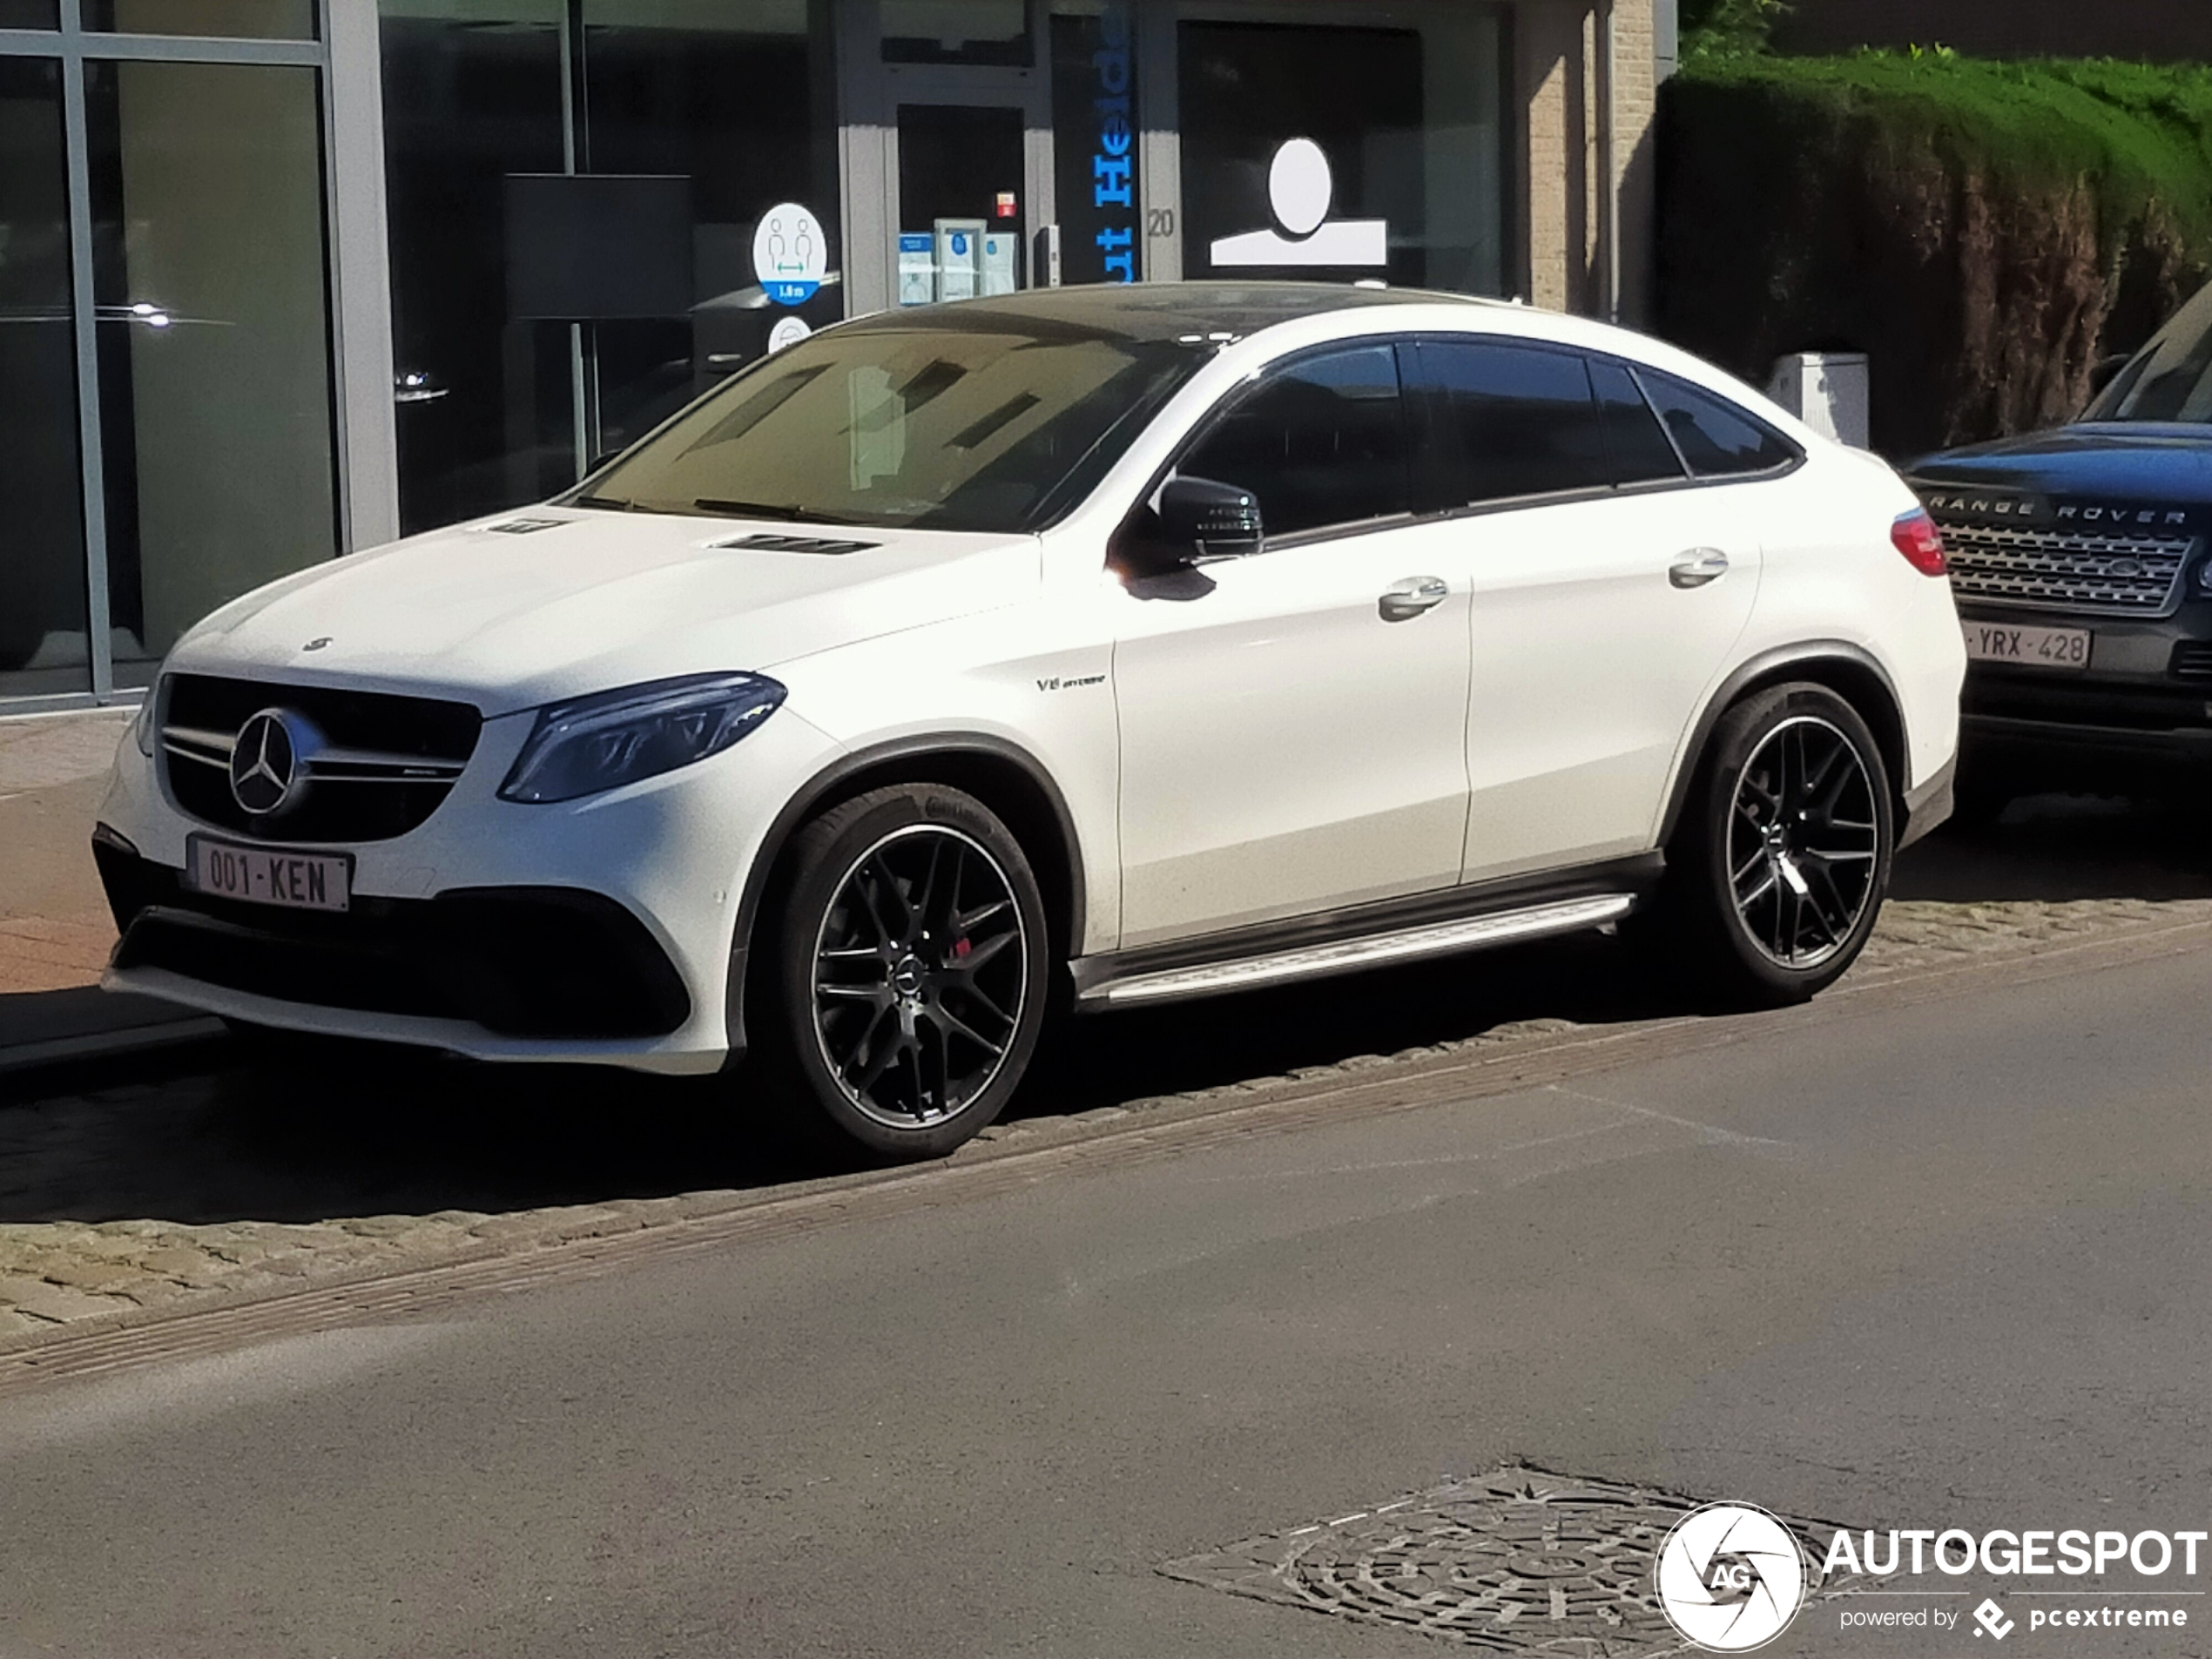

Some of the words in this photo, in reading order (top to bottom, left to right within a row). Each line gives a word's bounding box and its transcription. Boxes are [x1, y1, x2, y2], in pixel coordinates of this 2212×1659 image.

[1148, 209, 1174, 237] 20
[1929, 496, 2036, 516] RANGE
[2056, 505, 2187, 524] ROVER
[210, 849, 327, 903] 001-KEN
